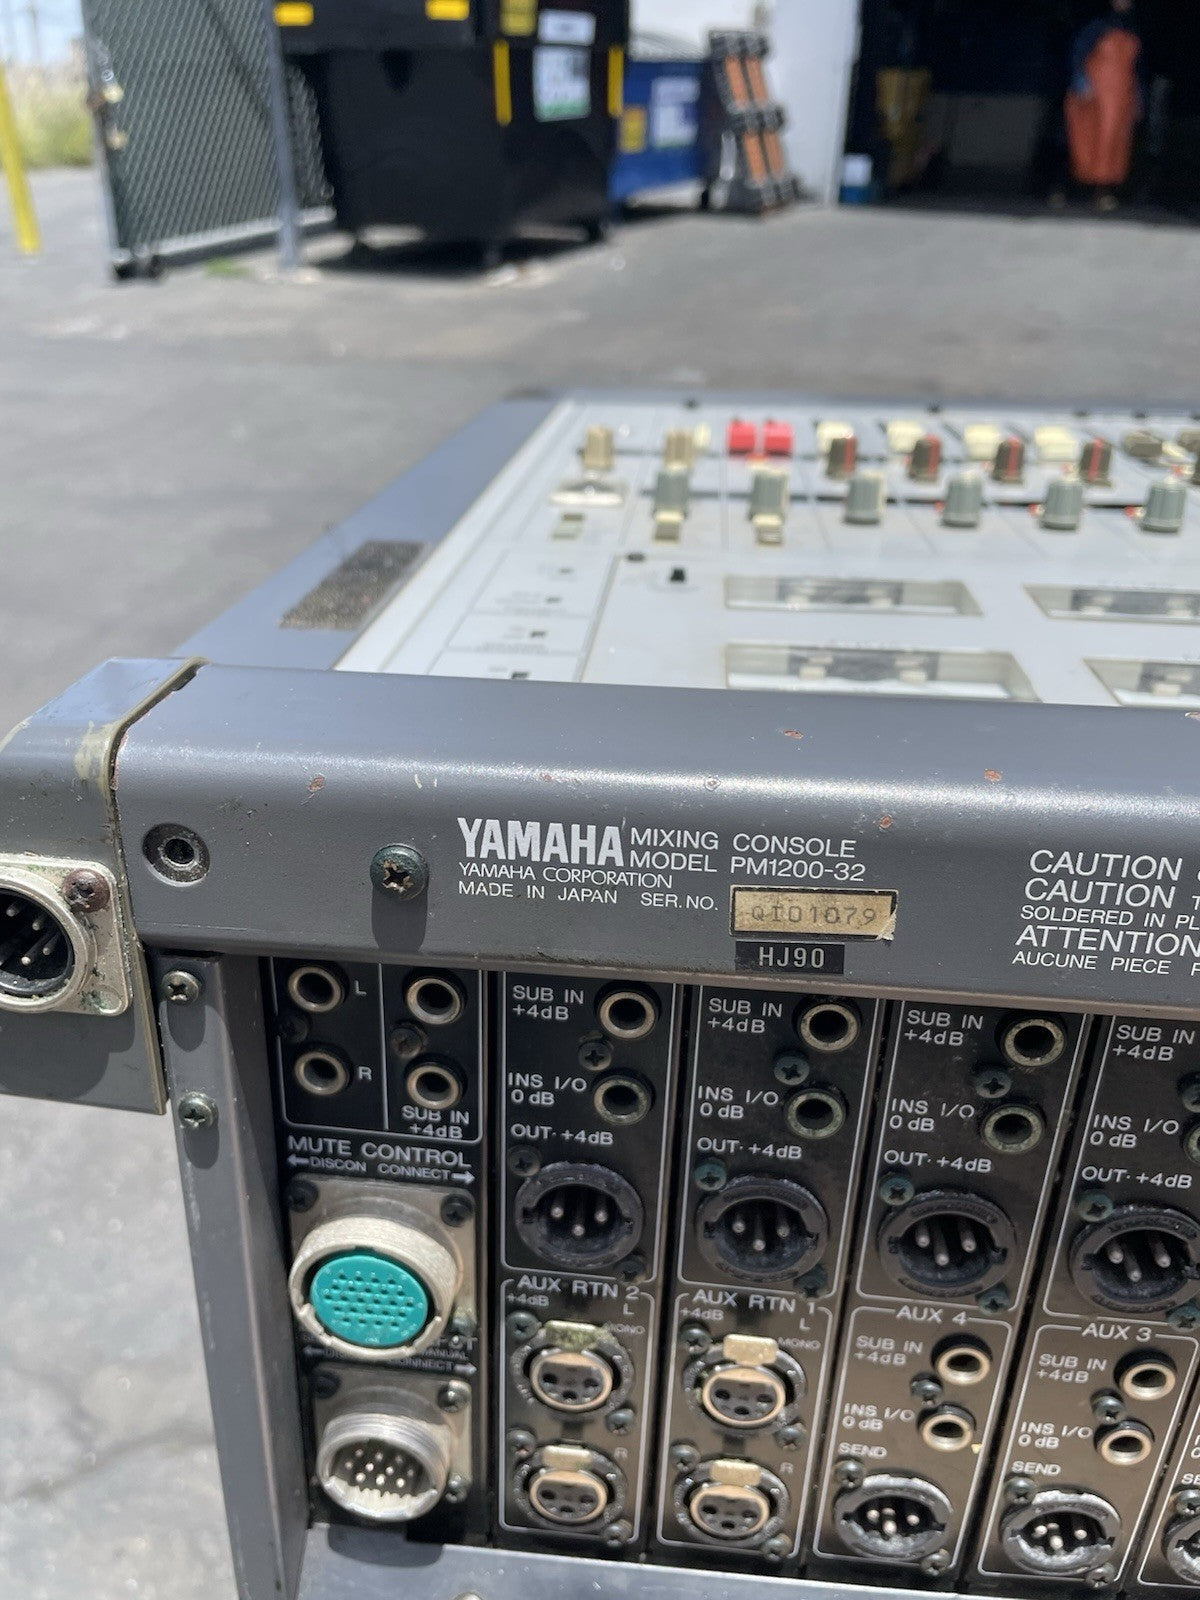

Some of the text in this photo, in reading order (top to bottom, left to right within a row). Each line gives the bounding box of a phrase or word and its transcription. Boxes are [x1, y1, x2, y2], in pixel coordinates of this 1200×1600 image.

[457, 817, 625, 867] YAMAHA
[630, 826, 856, 859] MIXING CONSOLE
[630, 850, 866, 883] MODEL PM1200-32
[1030, 849, 1183, 881] CAUTION
[458, 862, 672, 889] YAMAHA CORPORATION
[459, 881, 513, 898] MADE
[527, 885, 545, 900] IN
[558, 887, 618, 904] JAPAN
[1025, 877, 1176, 909] CAUTION
[1020, 904, 1133, 926] SOLDERED
[1143, 913, 1165, 928] IN
[1015, 925, 1200, 957] ATTENTION
[758, 946, 825, 969] HJ90
[1012, 950, 1098, 970] AUCUNE
[1110, 957, 1172, 975] PIECE
[354, 979, 367, 996] L
[512, 984, 585, 1005] SUB IN
[512, 1004, 570, 1021] +4dB
[708, 996, 783, 1018] SUB IN
[706, 1015, 766, 1034] +4dB
[906, 1008, 984, 1030] SUB IN
[904, 1027, 964, 1047] +4dB
[1116, 1024, 1196, 1045] SUB IN
[1112, 1043, 1174, 1062] +4dB
[358, 1066, 373, 1082] R
[508, 1071, 588, 1093] INS I/O
[510, 1089, 555, 1106] 0 dB
[698, 1085, 779, 1107] INS I/O
[450, 1110, 470, 1126] IN
[699, 1102, 744, 1120] 0 dB
[890, 1098, 975, 1120] INS I/O
[409, 1122, 463, 1140] +4dB
[888, 1114, 935, 1133] 0 dB
[1093, 1114, 1180, 1135] INS I/O
[560, 1128, 614, 1146] +4dB
[1089, 1130, 1137, 1149] 0 dB
[287, 1134, 471, 1169] MUTE CONTROL
[748, 1140, 802, 1159] +4dB
[310, 1156, 451, 1180] DISCON CONNECT
[936, 1153, 992, 1174] +4dB
[1135, 1171, 1193, 1189] +4dB
[517, 1274, 640, 1300] AUX RTN 2
[623, 1303, 635, 1316] L
[692, 1289, 817, 1315] AUX RTN 1
[800, 1318, 811, 1332] L
[895, 1304, 968, 1326] AUX 4
[1082, 1322, 1152, 1343] AUX 3
[777, 1336, 821, 1351] MONO
[855, 1335, 924, 1355] SUB IN
[854, 1349, 908, 1366] +4dB
[1038, 1353, 1108, 1372] SUB IN
[1036, 1368, 1090, 1385] +4dB
[843, 1402, 916, 1422] INS I/O
[858, 1417, 884, 1432] dB
[1020, 1420, 1094, 1439] INS I/O
[838, 1441, 888, 1459] SEND
[1034, 1435, 1060, 1451] dB
[1010, 1460, 1061, 1477] SEND
